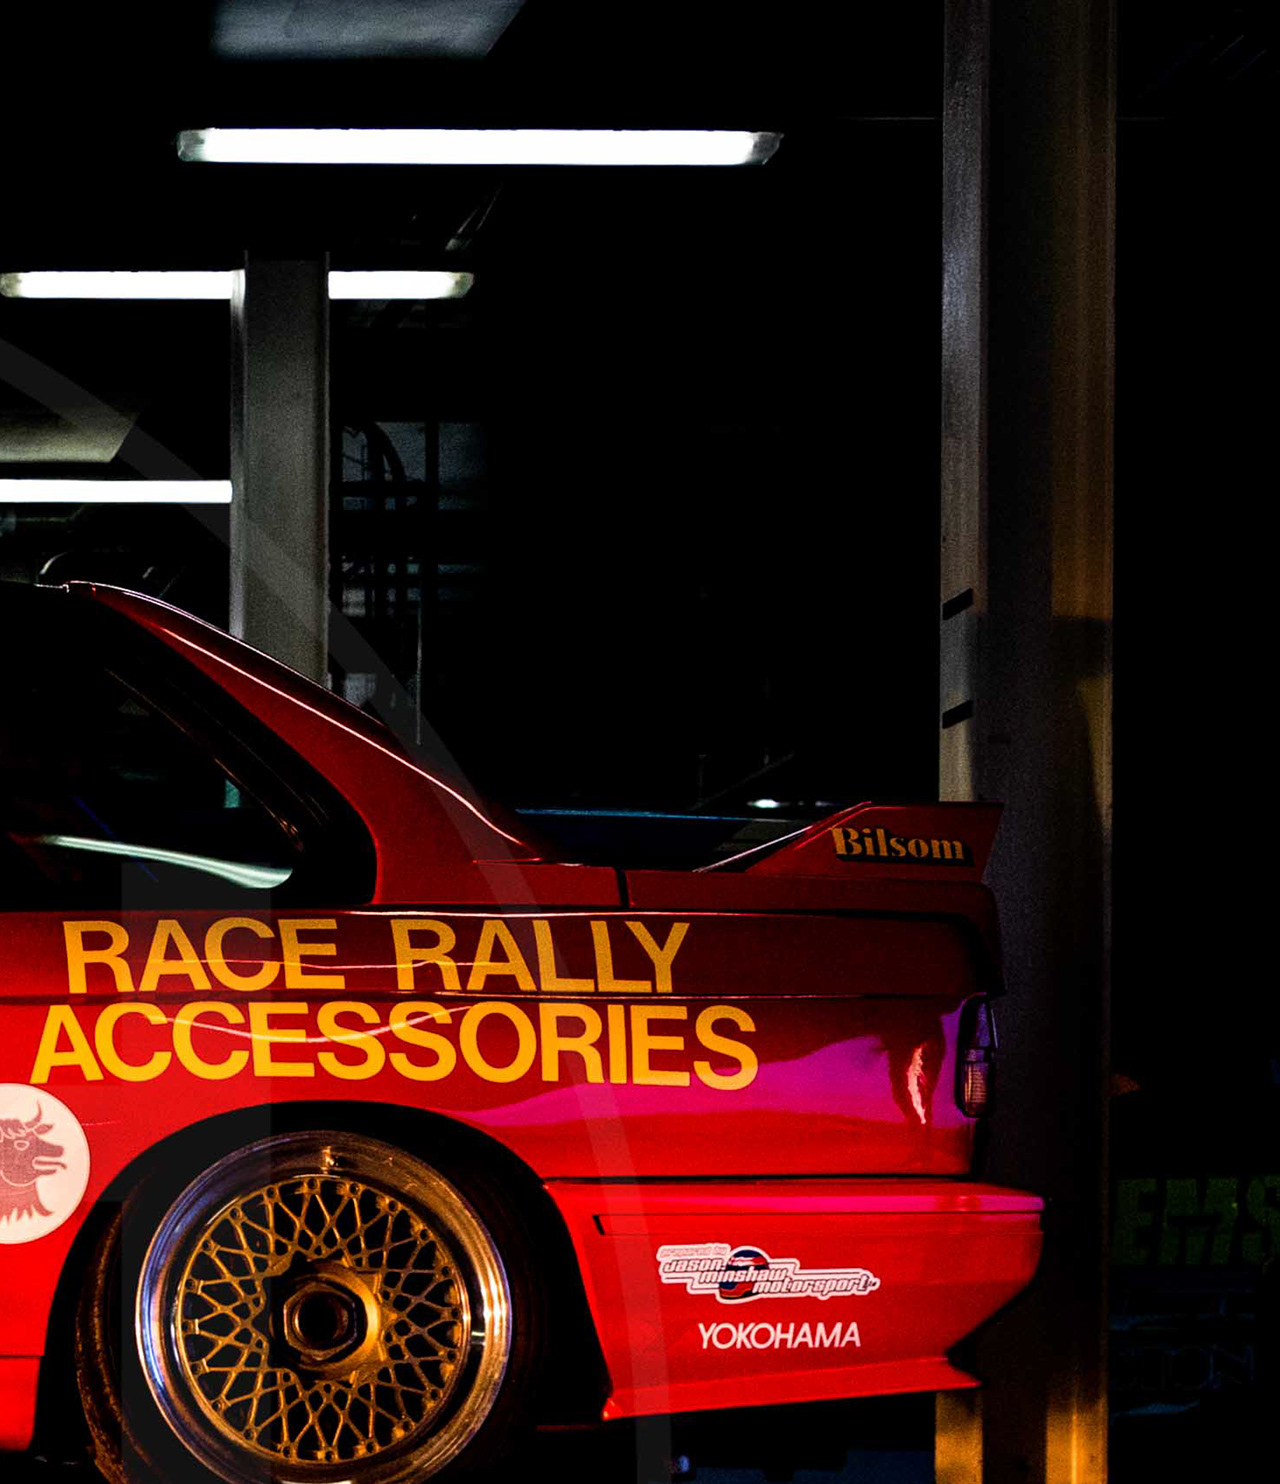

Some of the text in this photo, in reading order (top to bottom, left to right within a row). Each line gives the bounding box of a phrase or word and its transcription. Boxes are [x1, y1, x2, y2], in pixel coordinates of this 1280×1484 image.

[831, 827, 965, 861] Bilsom
[62, 918, 691, 994] RACE RALLY
[29, 1001, 760, 1092] ACCESSORIES
[698, 1321, 862, 1350] YOKOHAMA
